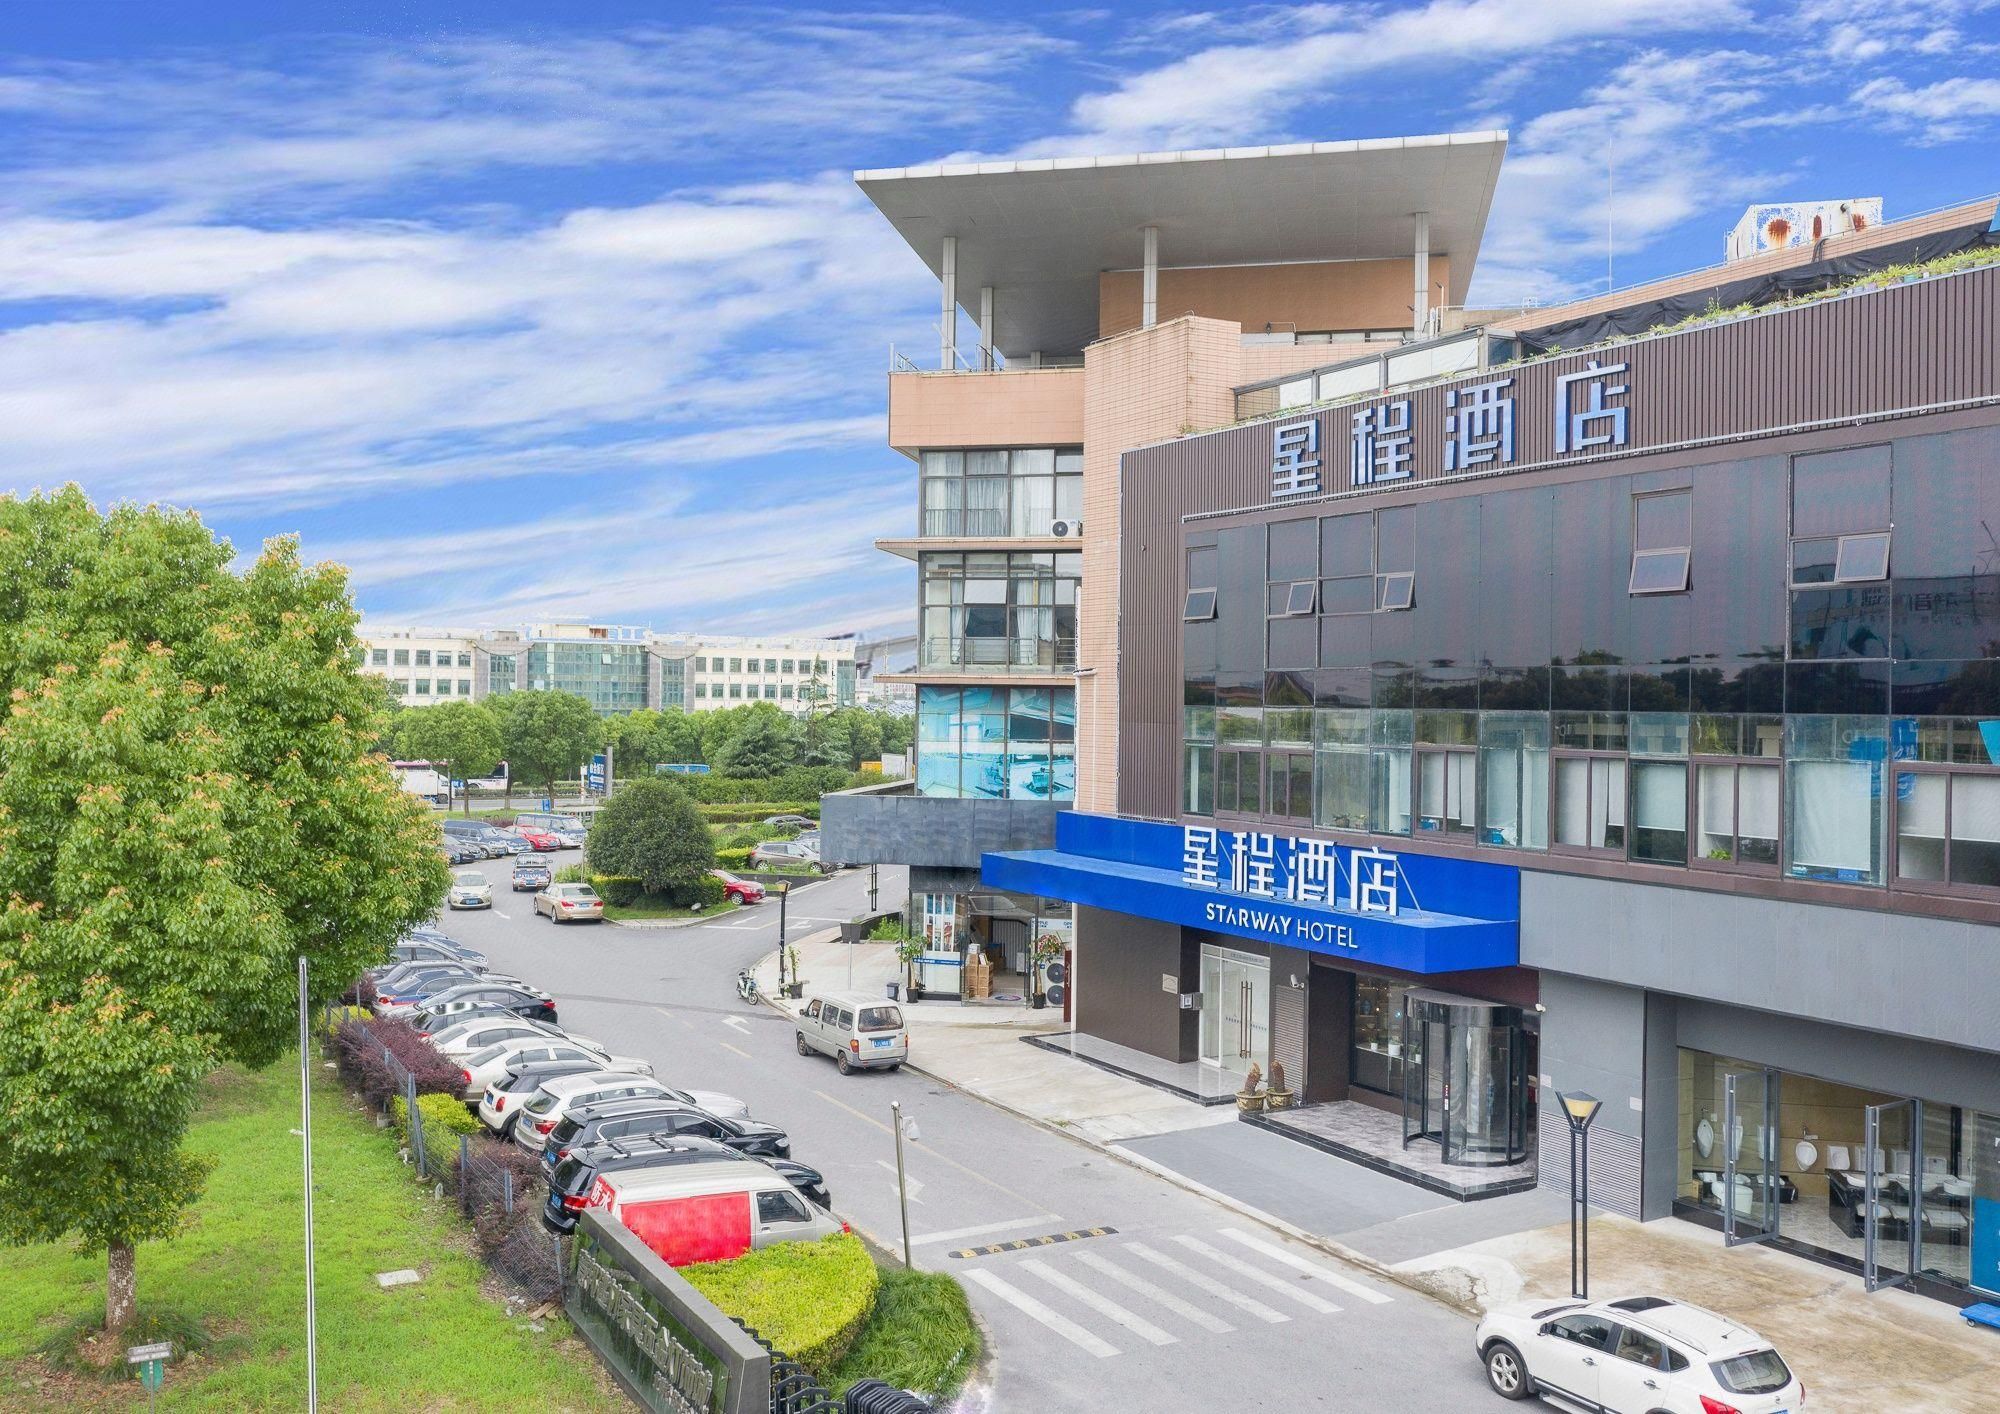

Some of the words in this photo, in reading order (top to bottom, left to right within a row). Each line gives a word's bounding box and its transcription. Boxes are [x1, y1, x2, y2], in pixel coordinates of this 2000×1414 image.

[1272, 360, 1630, 497] 星程酒店
[1182, 825, 1400, 916] 星程酒店
[1206, 902, 1291, 935] STARWAY
[1297, 920, 1358, 949] HOTEL
